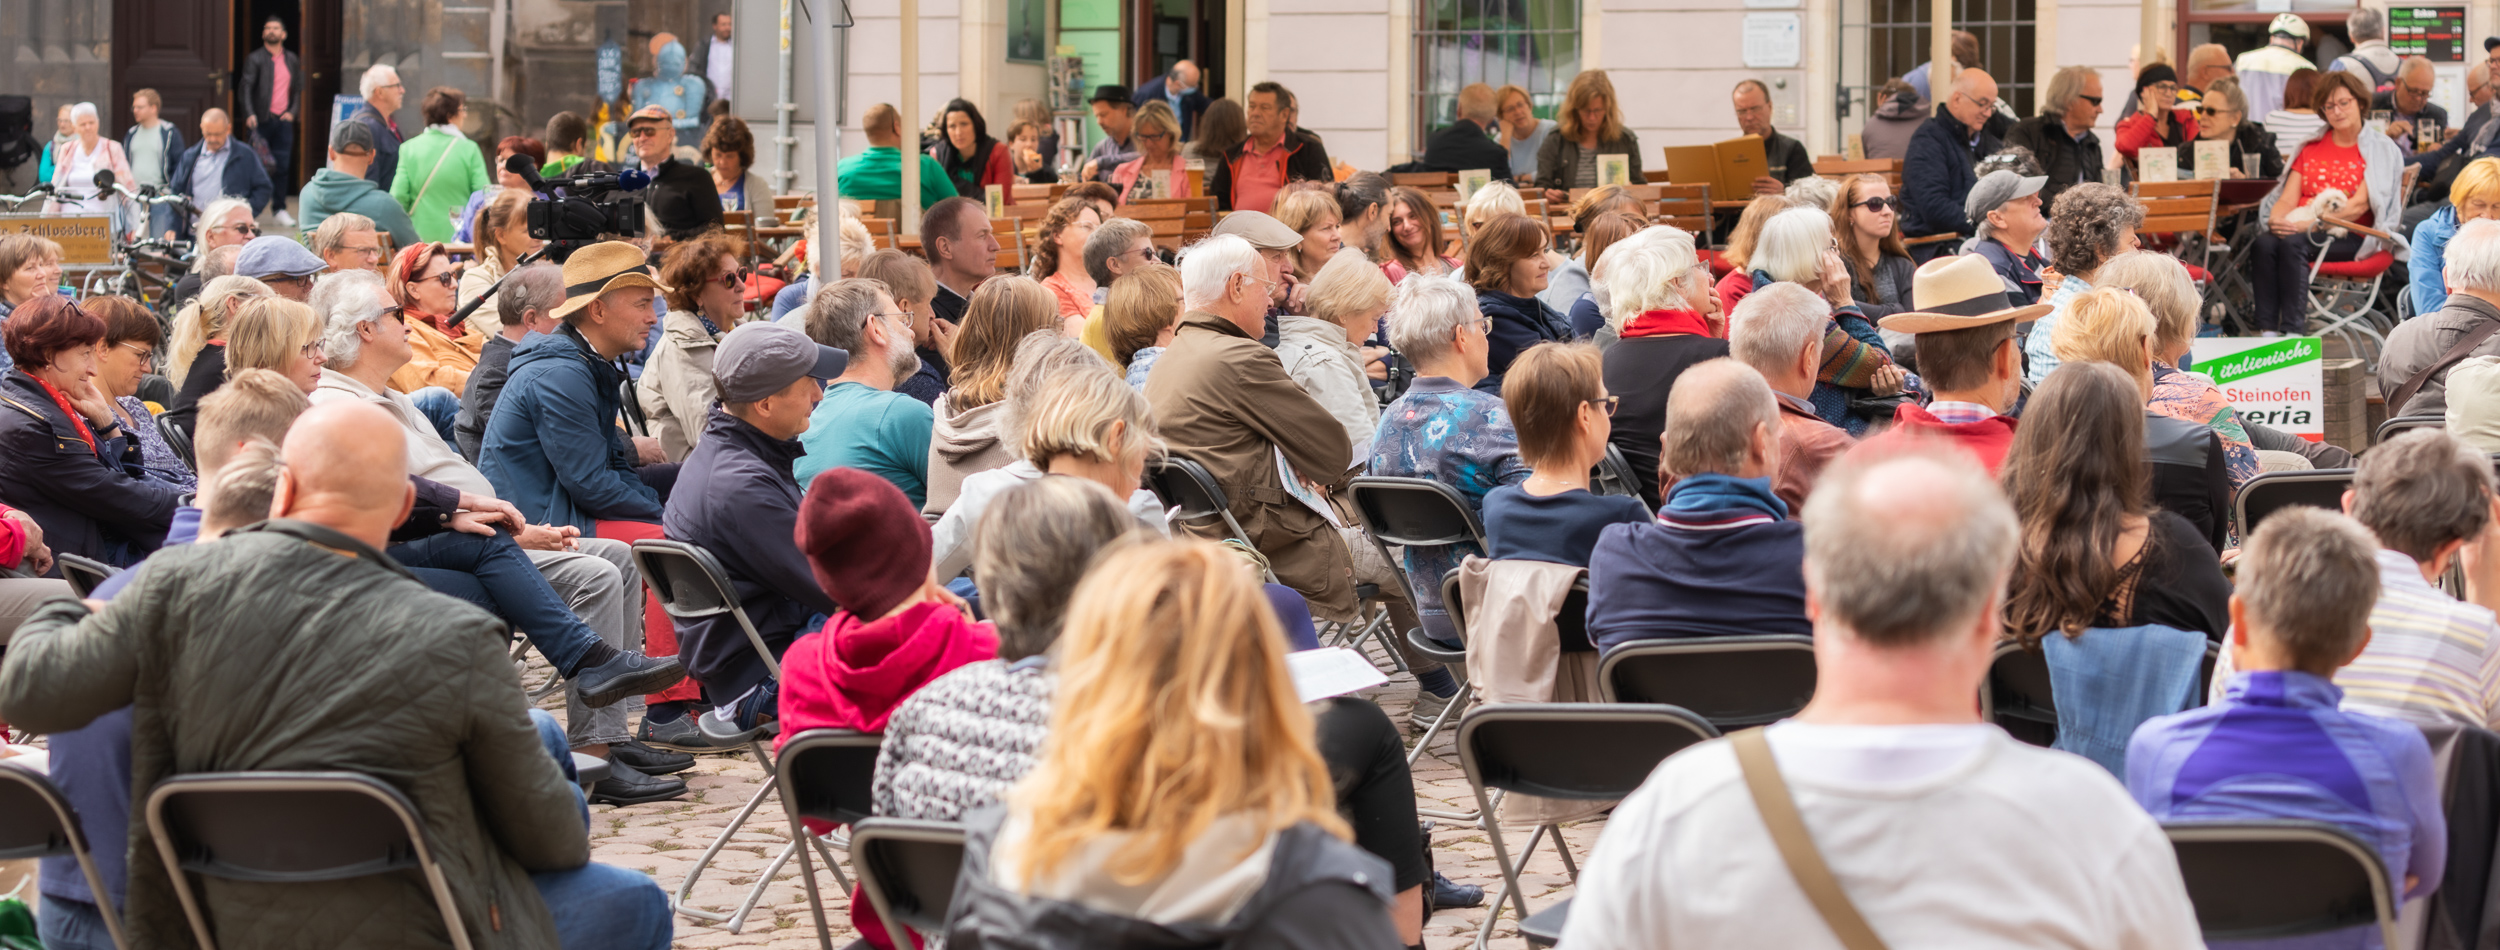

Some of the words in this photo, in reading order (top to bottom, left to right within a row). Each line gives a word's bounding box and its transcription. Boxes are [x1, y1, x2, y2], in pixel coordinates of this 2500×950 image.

[2220, 340, 2313, 379] italienische
[2226, 387, 2311, 403] Steinofen
[2237, 405, 2311, 425] eria
